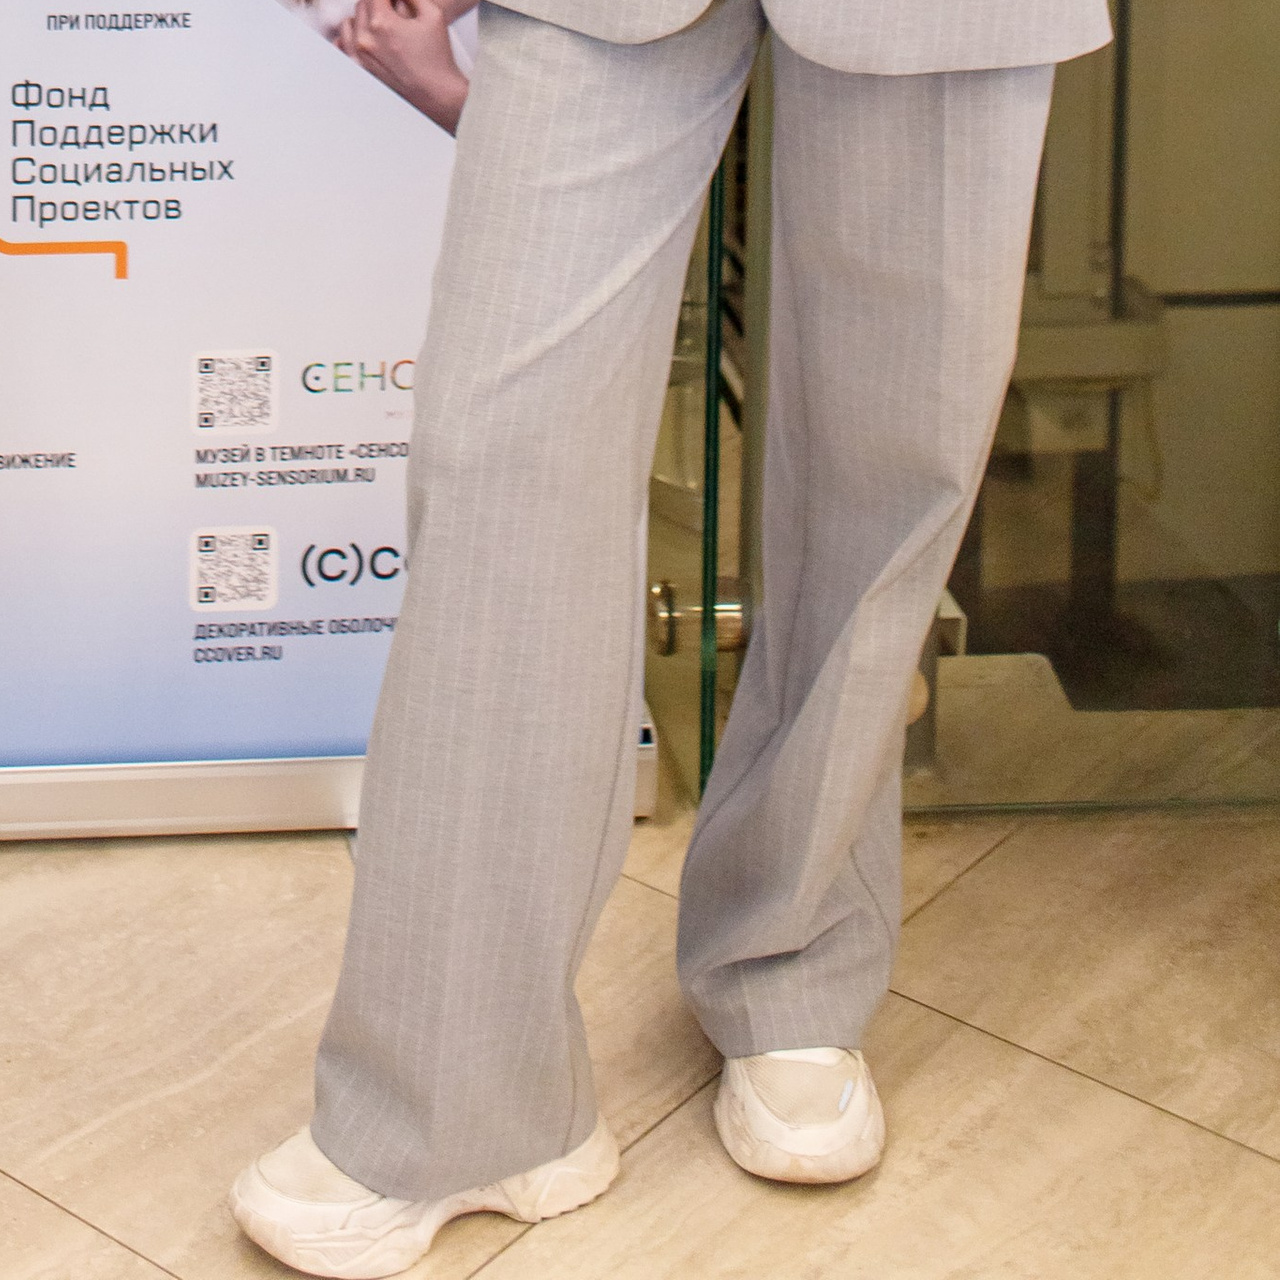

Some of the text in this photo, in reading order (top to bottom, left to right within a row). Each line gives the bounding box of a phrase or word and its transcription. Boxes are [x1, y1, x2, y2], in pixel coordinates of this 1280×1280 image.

[46, 12, 192, 31] ПРИ ПОДДЕРЖКЕ
[11, 80, 110, 111] Фонд
[11, 120, 218, 151] Поддержки
[11, 156, 235, 186] Социальных
[11, 195, 183, 228] Проектов
[195, 444, 251, 464] МУЗЕЙ
[256, 447, 266, 462] В
[270, 444, 345, 462] ТЕМНОТЕ
[193, 617, 399, 640] ДЕКОРАТИВНЫЕ ОБОЛОЧ
